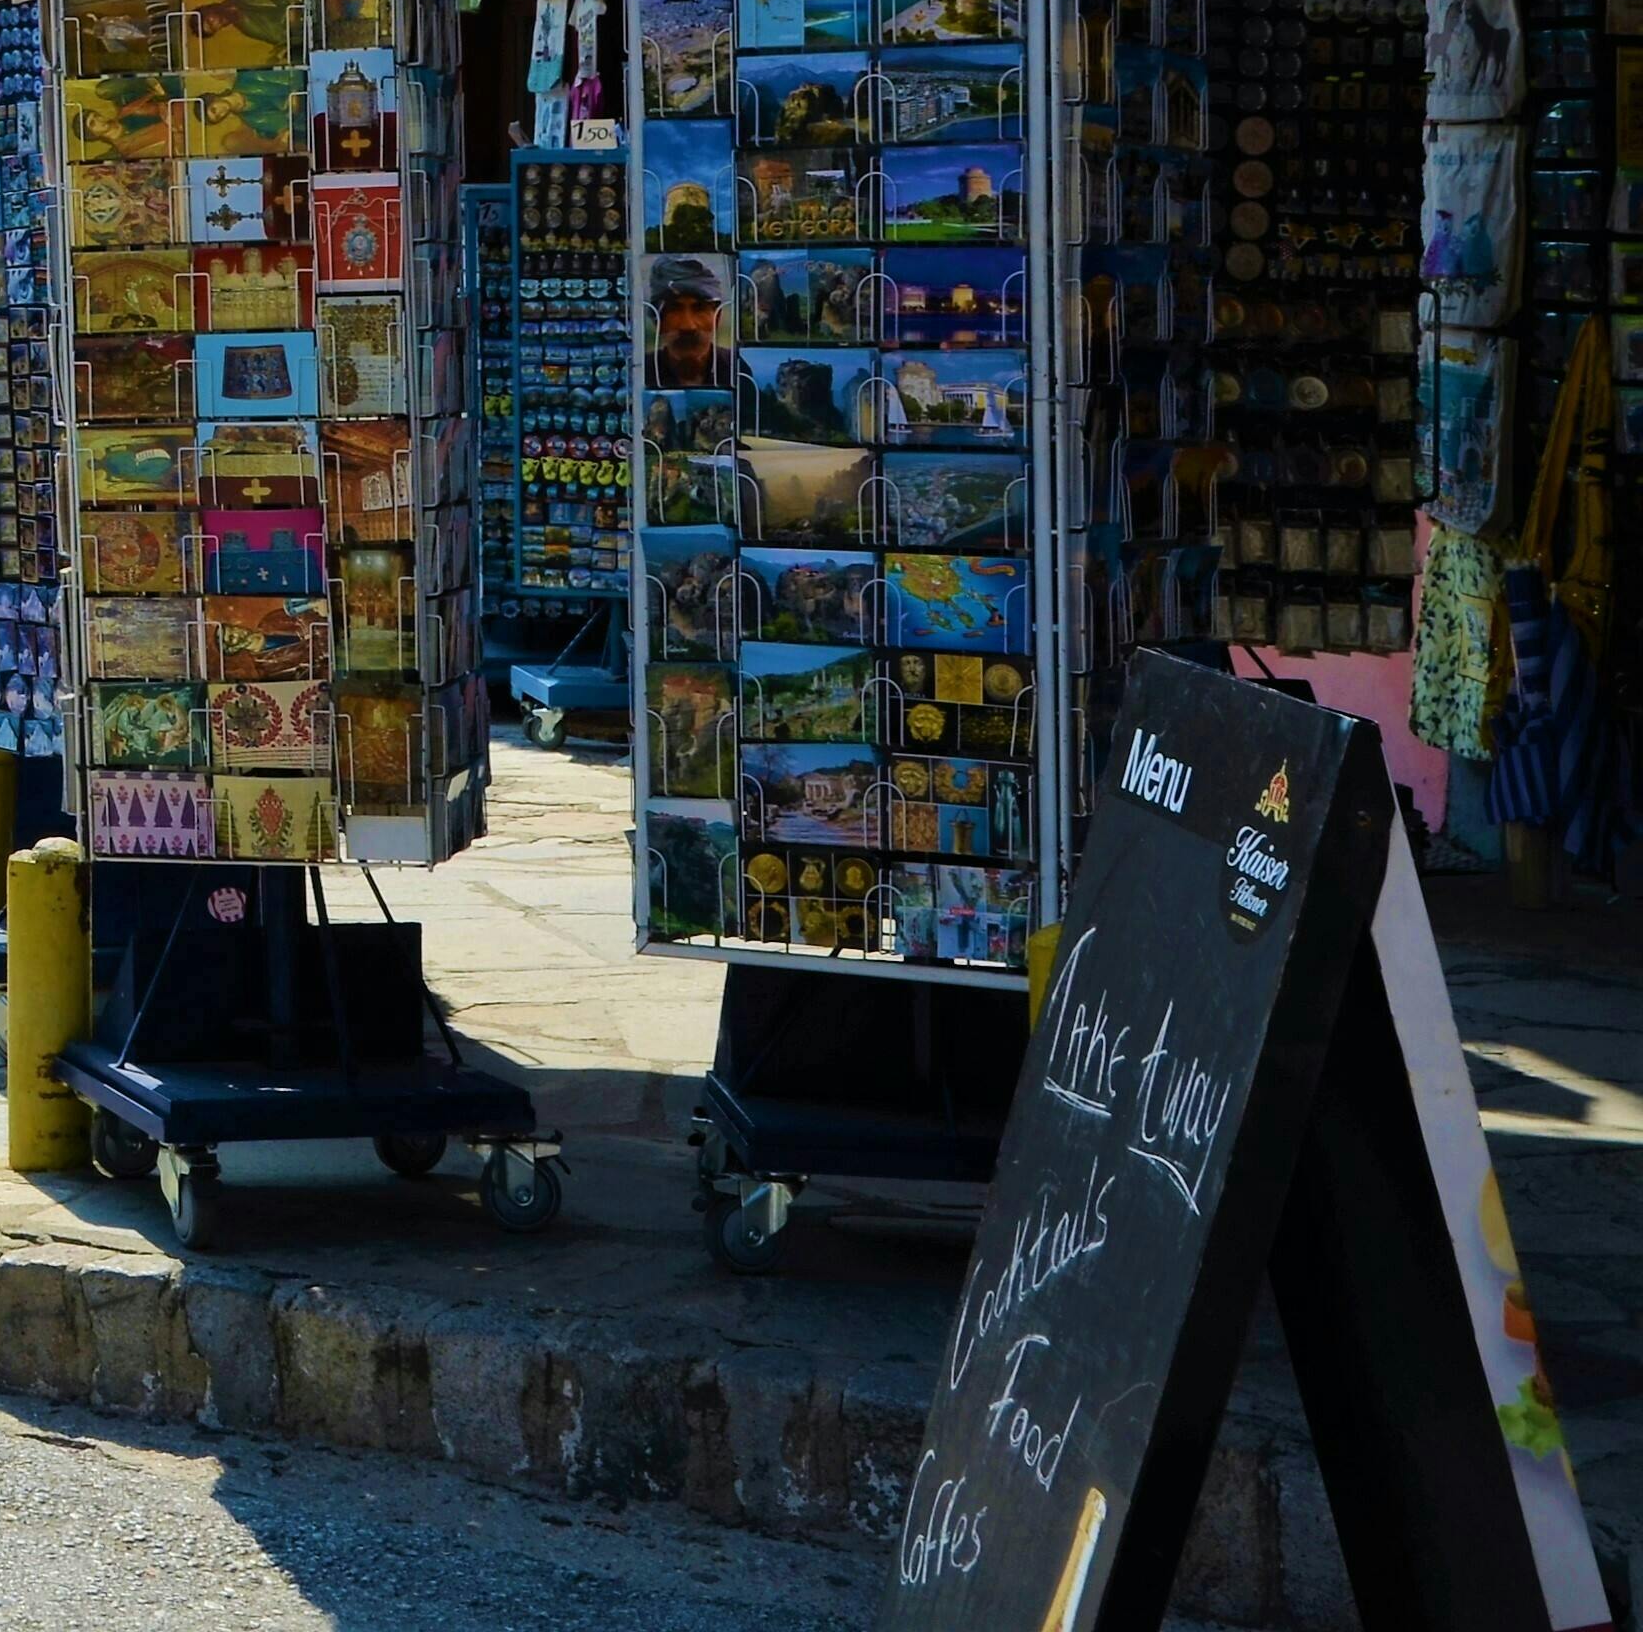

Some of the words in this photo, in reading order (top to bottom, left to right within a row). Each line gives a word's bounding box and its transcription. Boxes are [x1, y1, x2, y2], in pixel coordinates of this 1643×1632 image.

[1120, 727, 1193, 814] Menu
[1226, 825, 1290, 891] Kaiser
[1229, 876, 1270, 917] Pilsner
[987, 1333, 1083, 1493] Food
